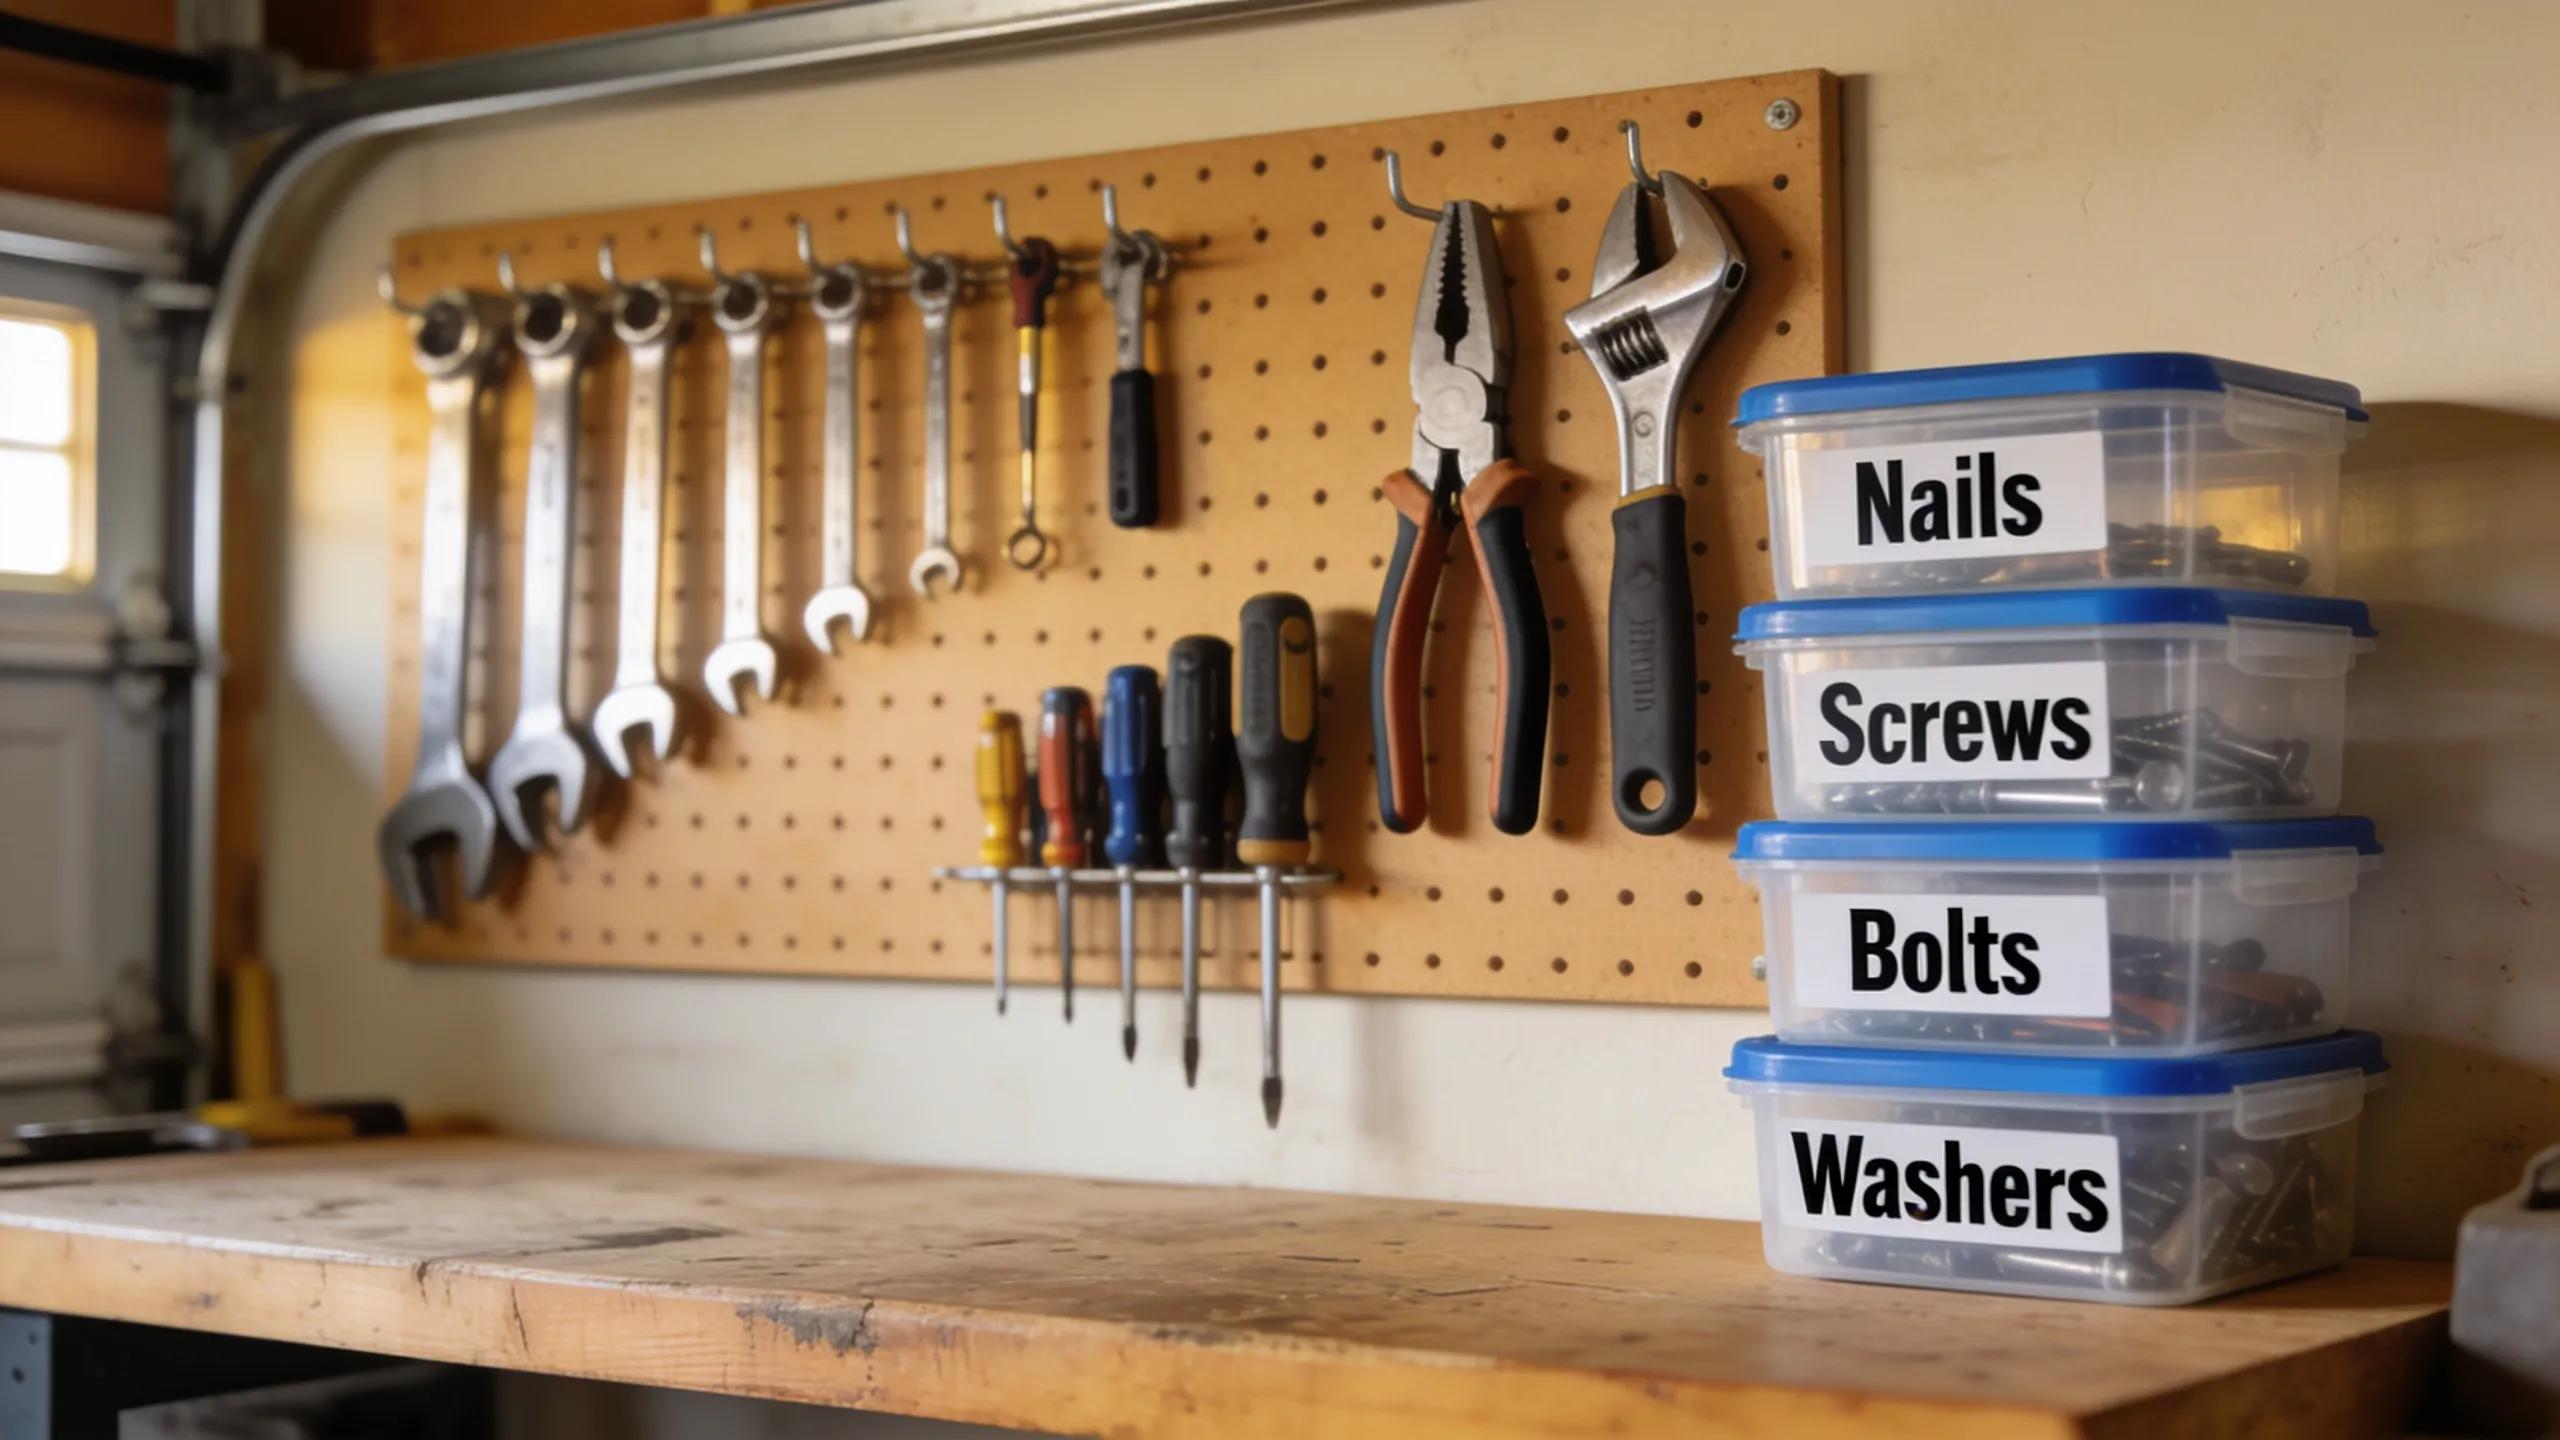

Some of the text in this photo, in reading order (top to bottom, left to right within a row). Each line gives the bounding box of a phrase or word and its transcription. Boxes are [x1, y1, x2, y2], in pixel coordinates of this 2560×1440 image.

[1854, 450, 2043, 546] Nails
[1818, 681, 2092, 766] Screws
[1848, 907, 2041, 996] Bolts
[1789, 1130, 2109, 1233] Washers
